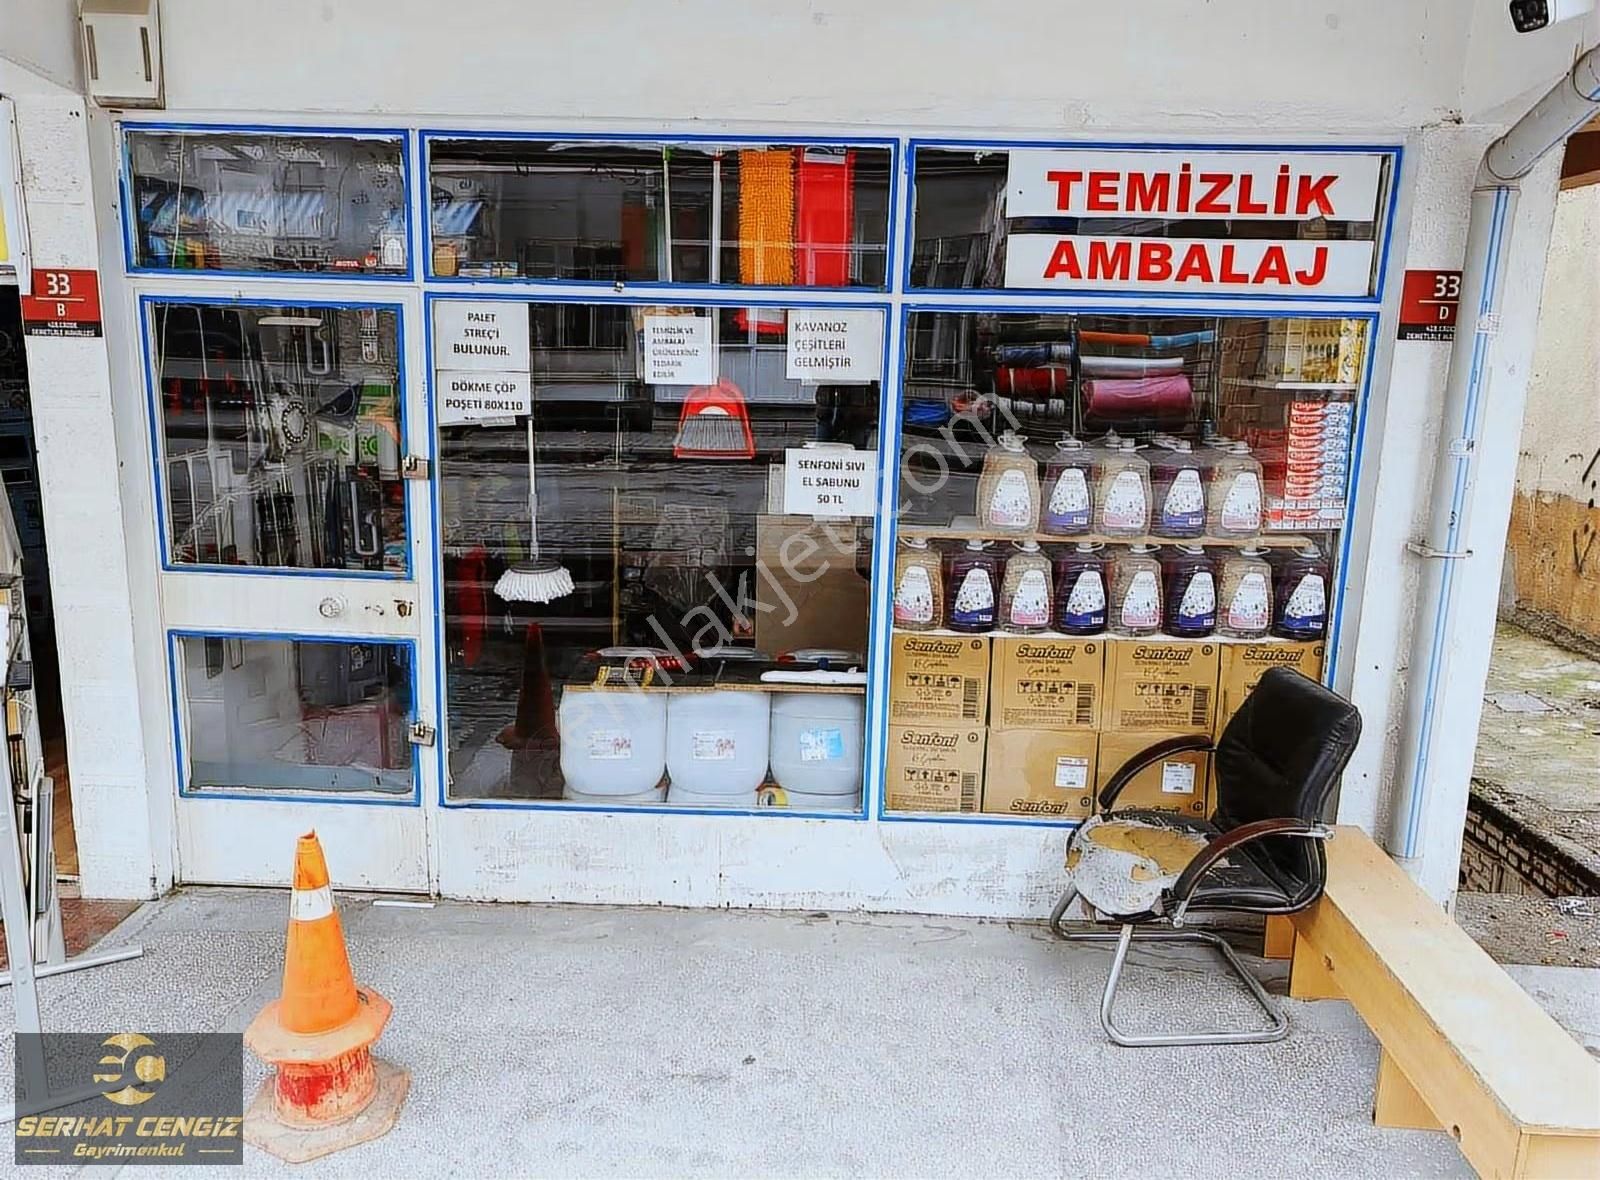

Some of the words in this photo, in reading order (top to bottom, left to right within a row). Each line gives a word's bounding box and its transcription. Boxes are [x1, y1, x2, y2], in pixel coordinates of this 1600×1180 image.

[1046, 162, 1340, 216] TEMİZLİK
[1042, 240, 1329, 286] AMBALAJ
[46, 272, 71, 295] 33
[1433, 275, 1460, 297] 33
[57, 302, 66, 317] B
[1439, 306, 1449, 320] D
[467, 312, 496, 323] PALET
[794, 321, 848, 334] KAVANOZ
[453, 343, 510, 356] BULUNUR.
[794, 337, 846, 352] ÇEŞİTLERİ
[794, 355, 851, 370] GELMİŞTİR
[451, 379, 493, 393] DÖKME
[494, 381, 517, 396] ÇÖP
[445, 397, 482, 411] POŞETİ
[484, 400, 523, 411] 80X110
[798, 458, 843, 471] SENFONİ
[845, 461, 865, 471] SIVI
[802, 476, 813, 486] EL
[816, 477, 860, 488] SABUNU
[817, 494, 830, 504] 50
[832, 495, 844, 504] TL
[904, 637, 963, 654] Senfoni
[1016, 643, 1076, 659] Senfoni
[1132, 645, 1193, 661] Senfoni
[901, 730, 959, 747] Senfoni
